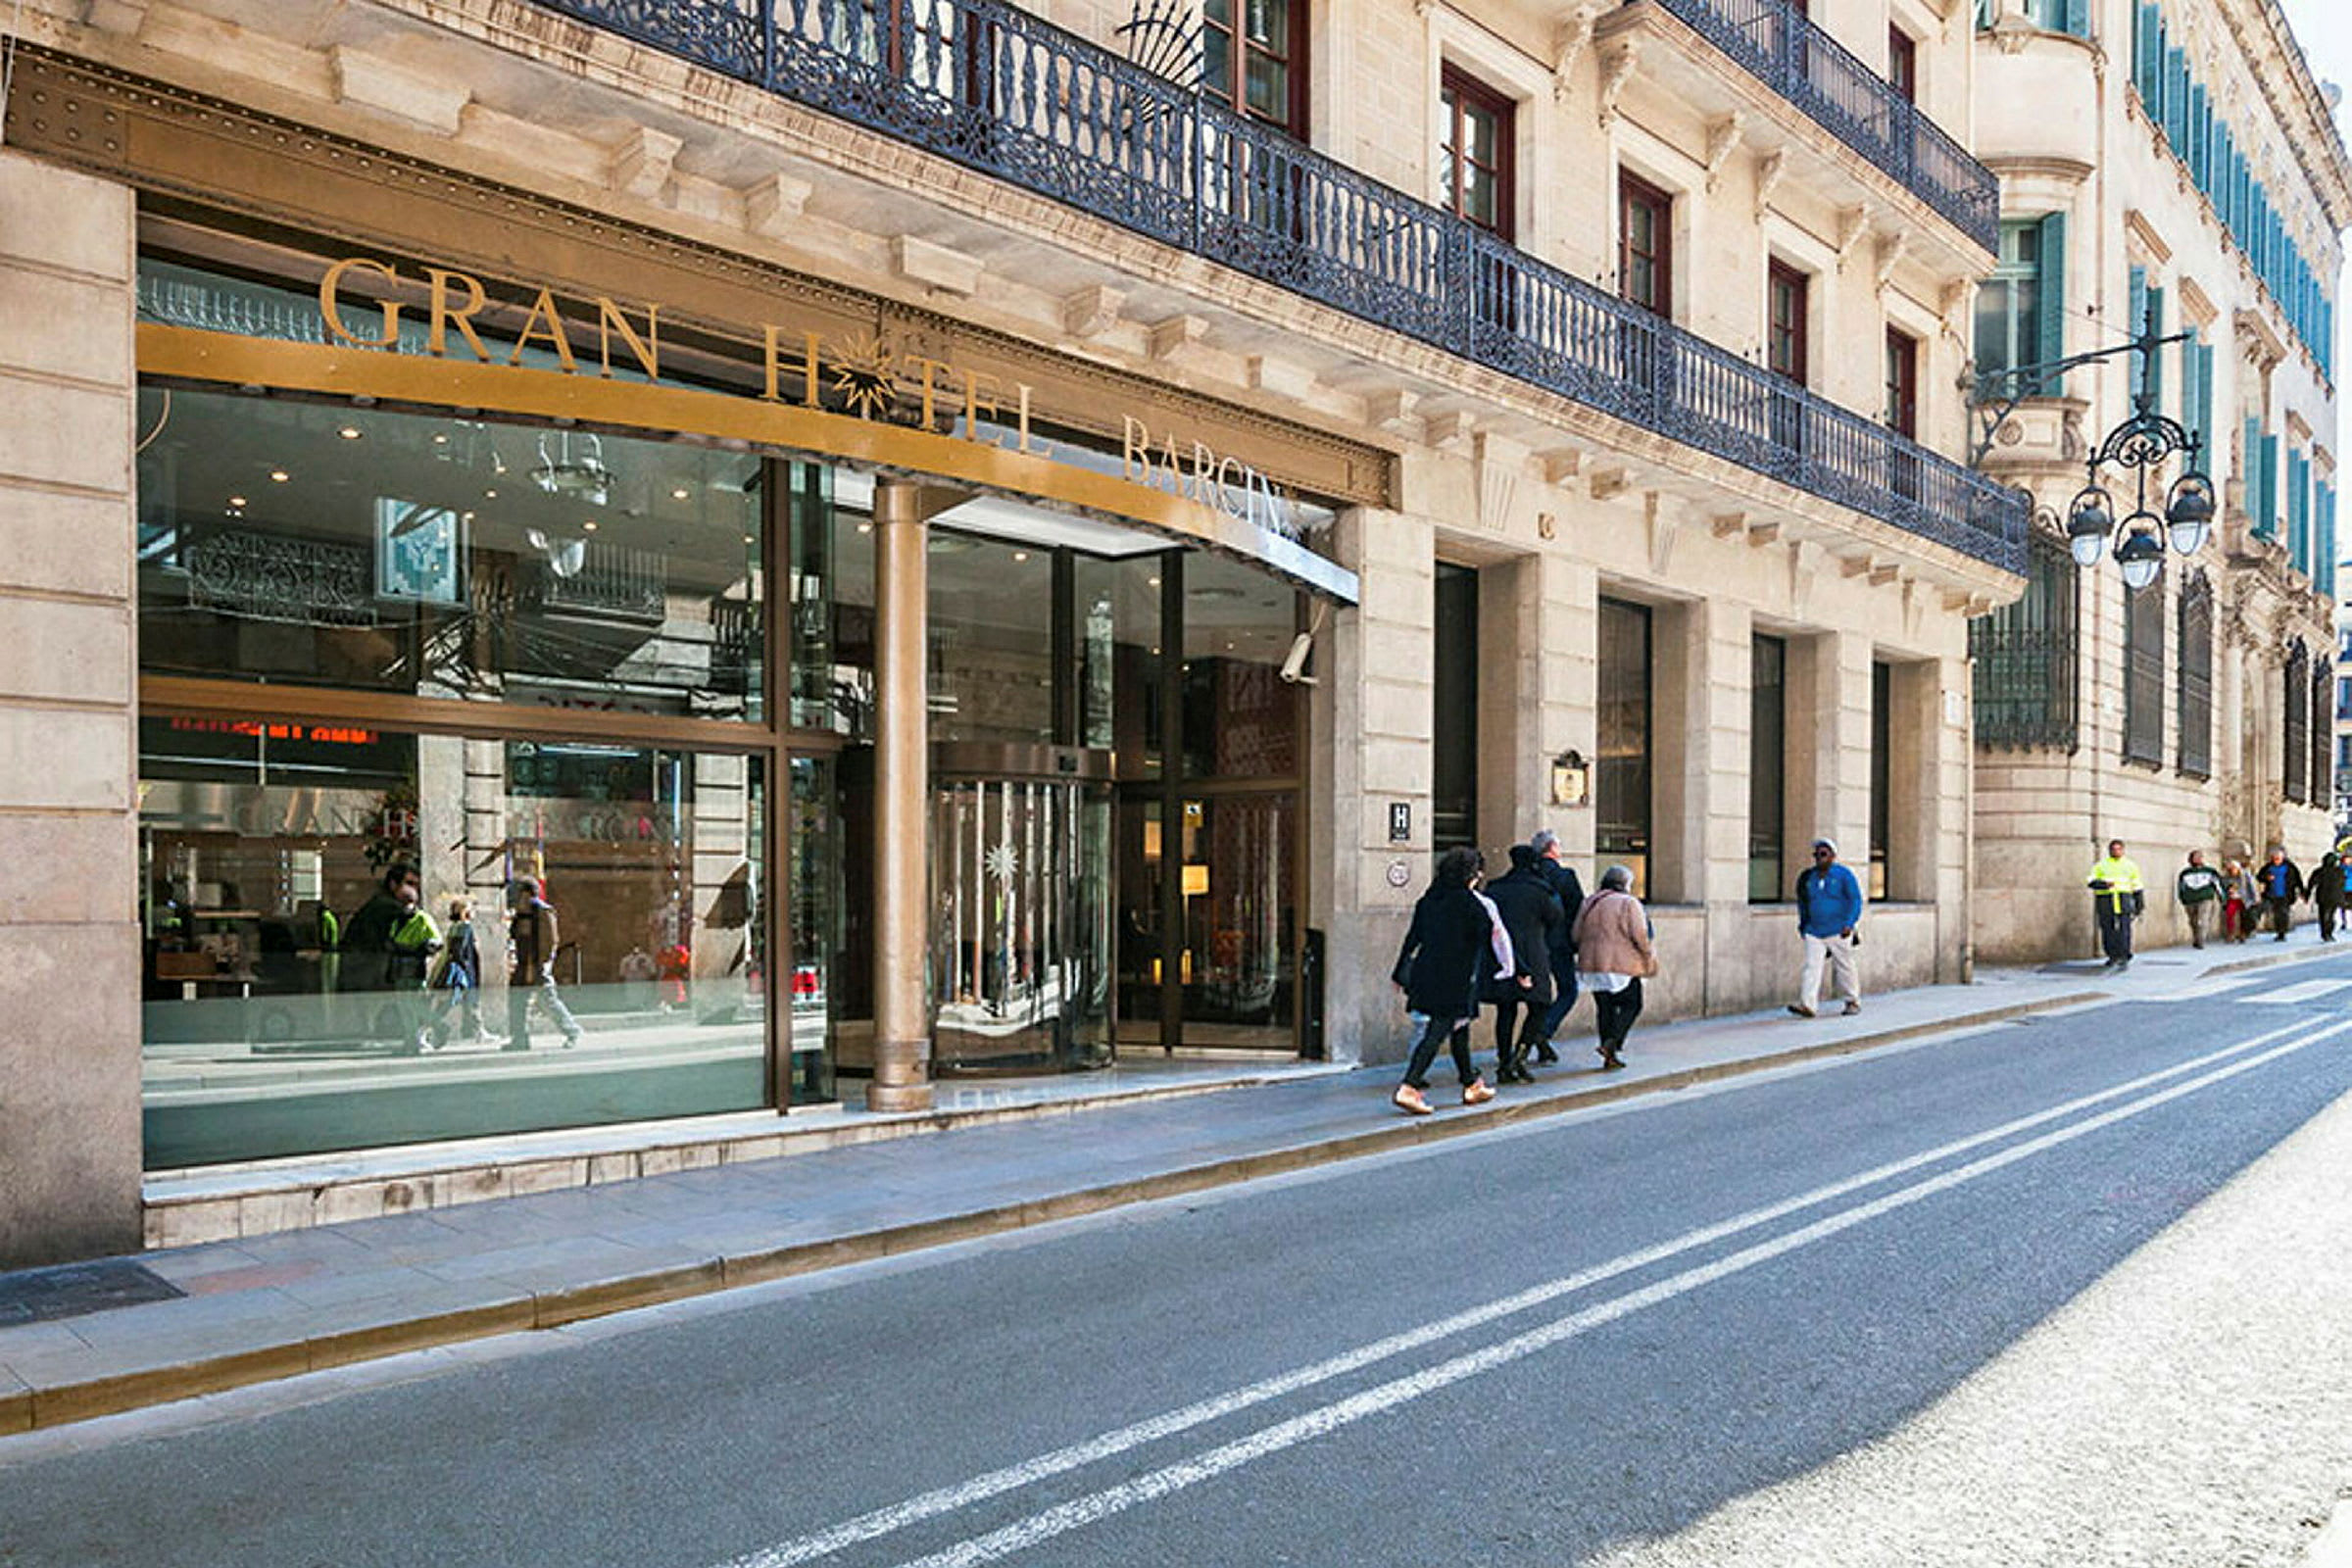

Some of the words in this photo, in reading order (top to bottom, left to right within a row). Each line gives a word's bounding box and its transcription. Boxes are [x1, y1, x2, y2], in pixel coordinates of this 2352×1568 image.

[320, 258, 662, 382] GRAN
[1121, 413, 1292, 538] BARCIN
[1396, 806, 1407, 828] H
